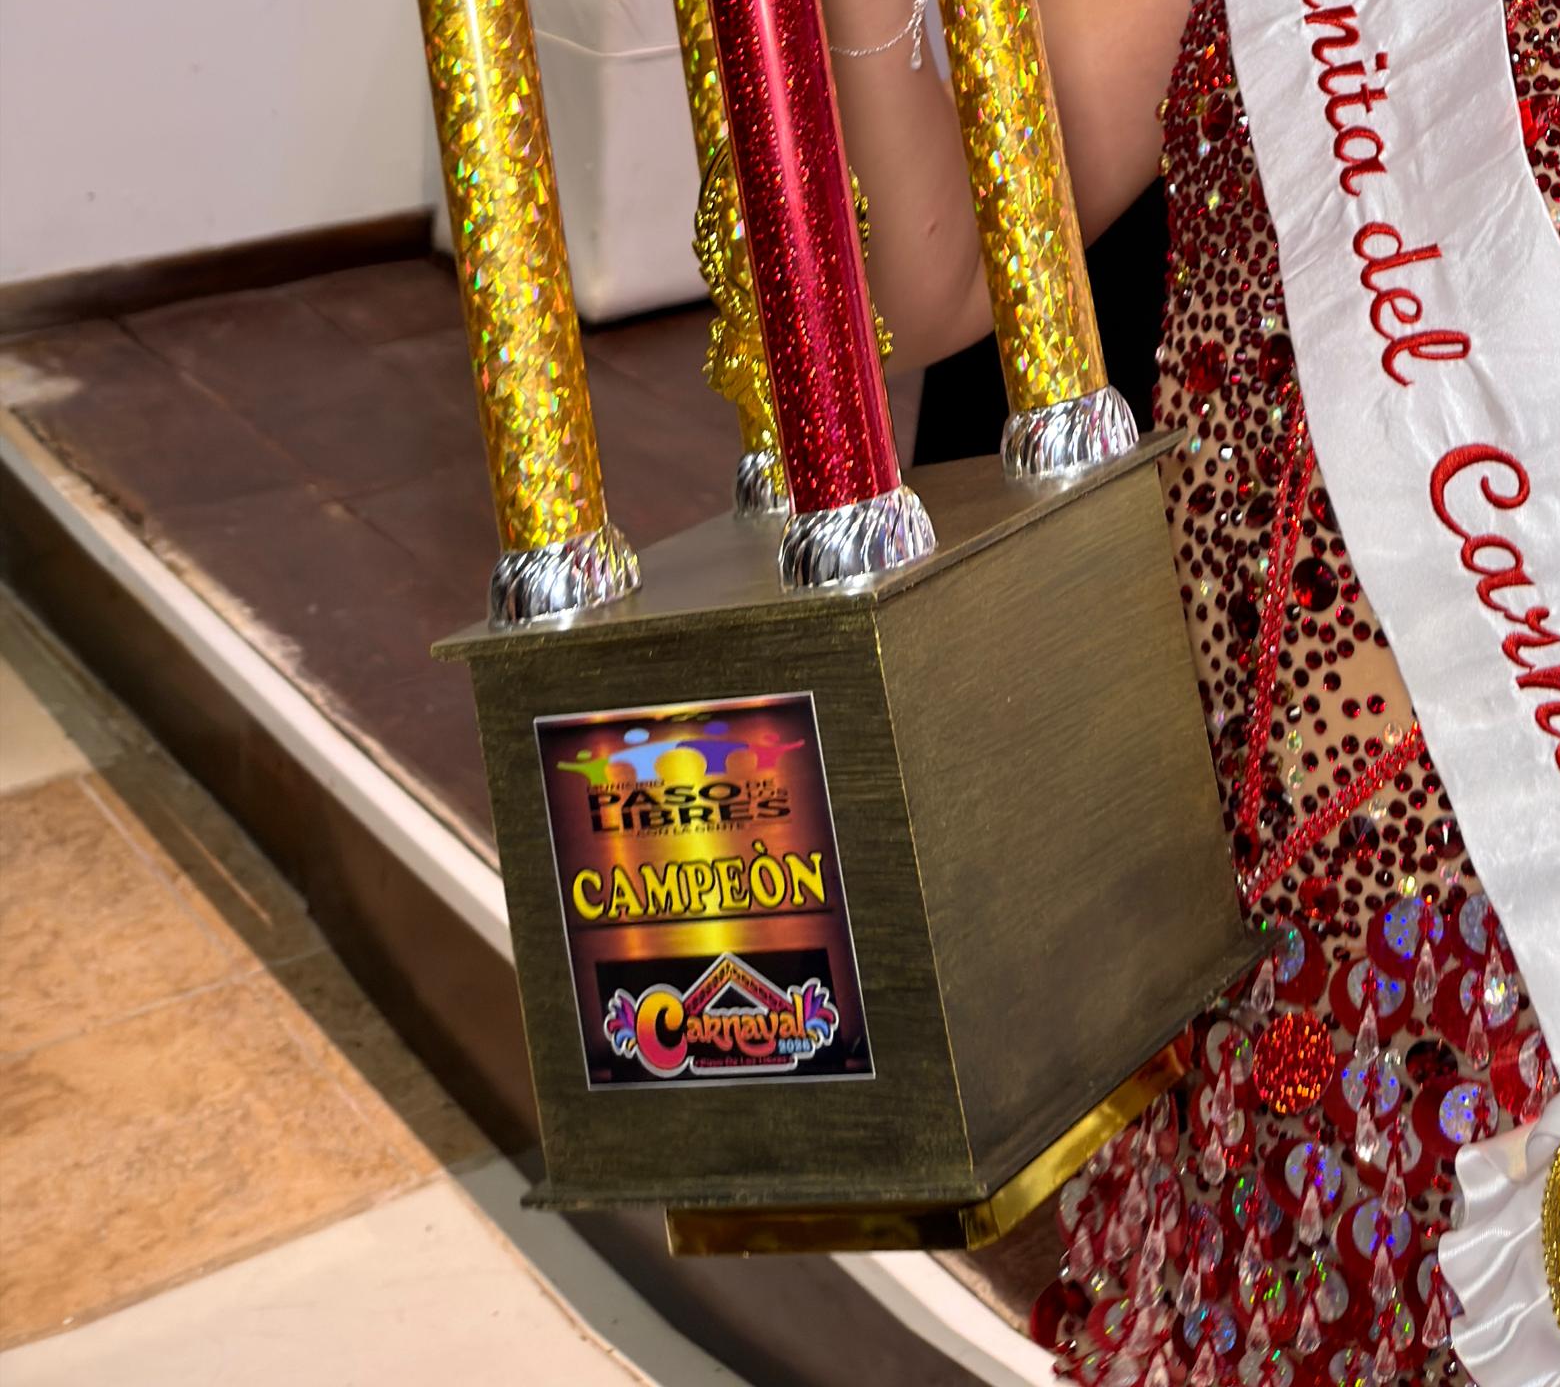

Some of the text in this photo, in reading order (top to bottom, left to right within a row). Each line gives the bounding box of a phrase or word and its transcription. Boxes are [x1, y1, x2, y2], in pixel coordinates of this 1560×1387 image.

[1353, 221, 1471, 387] del
[588, 781, 742, 811] PASO
[591, 798, 791, 832] LIBRES
